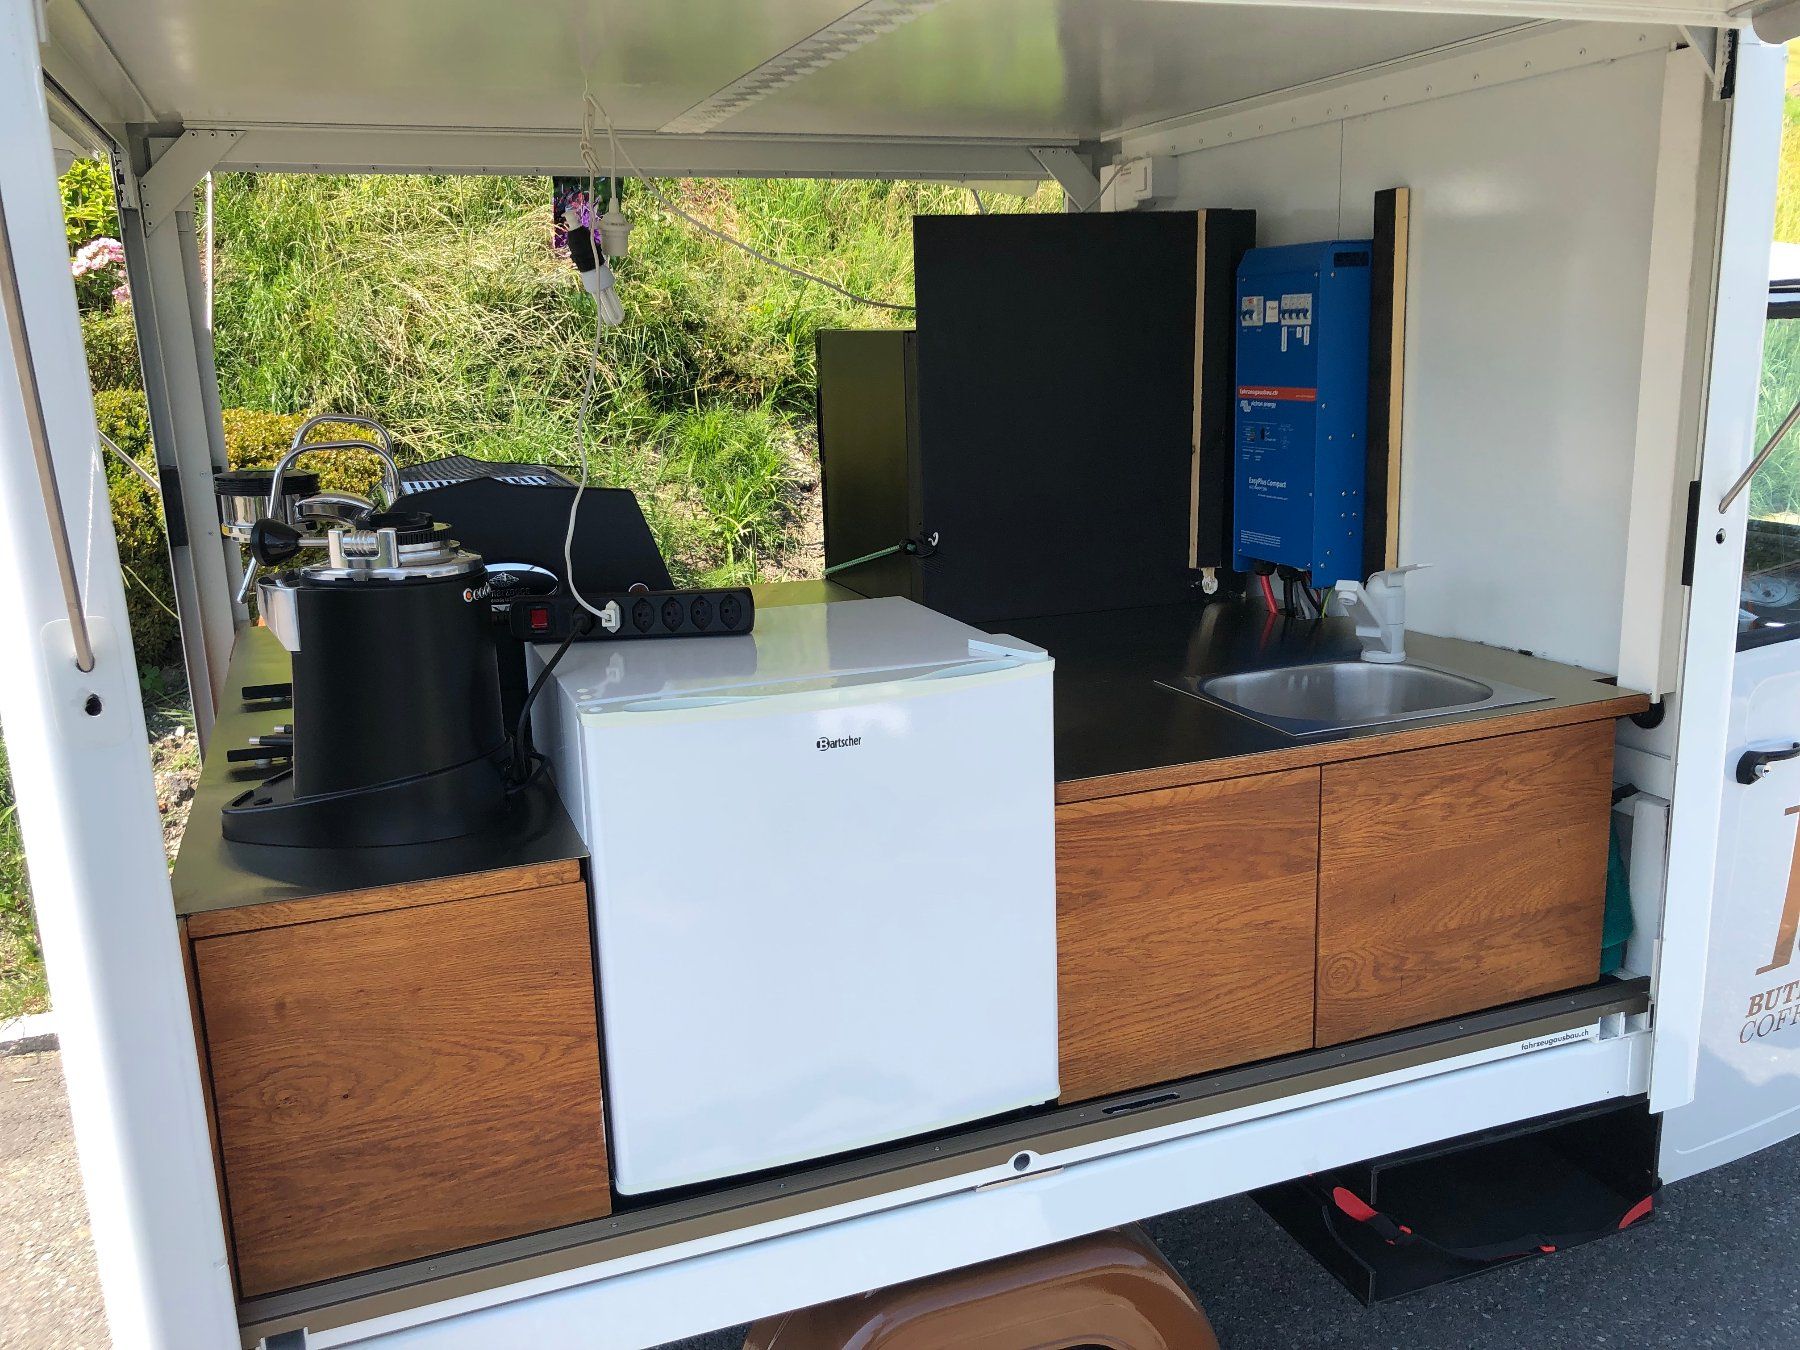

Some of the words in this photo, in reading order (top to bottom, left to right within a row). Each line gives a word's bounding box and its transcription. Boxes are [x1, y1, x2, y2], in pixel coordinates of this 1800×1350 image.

[1267, 479, 1287, 489] Compact
[816, 734, 862, 751] Bartscher
[1745, 980, 1800, 1018] BUT
[1521, 1029, 1589, 1050] fahrzeugausbau.ch
